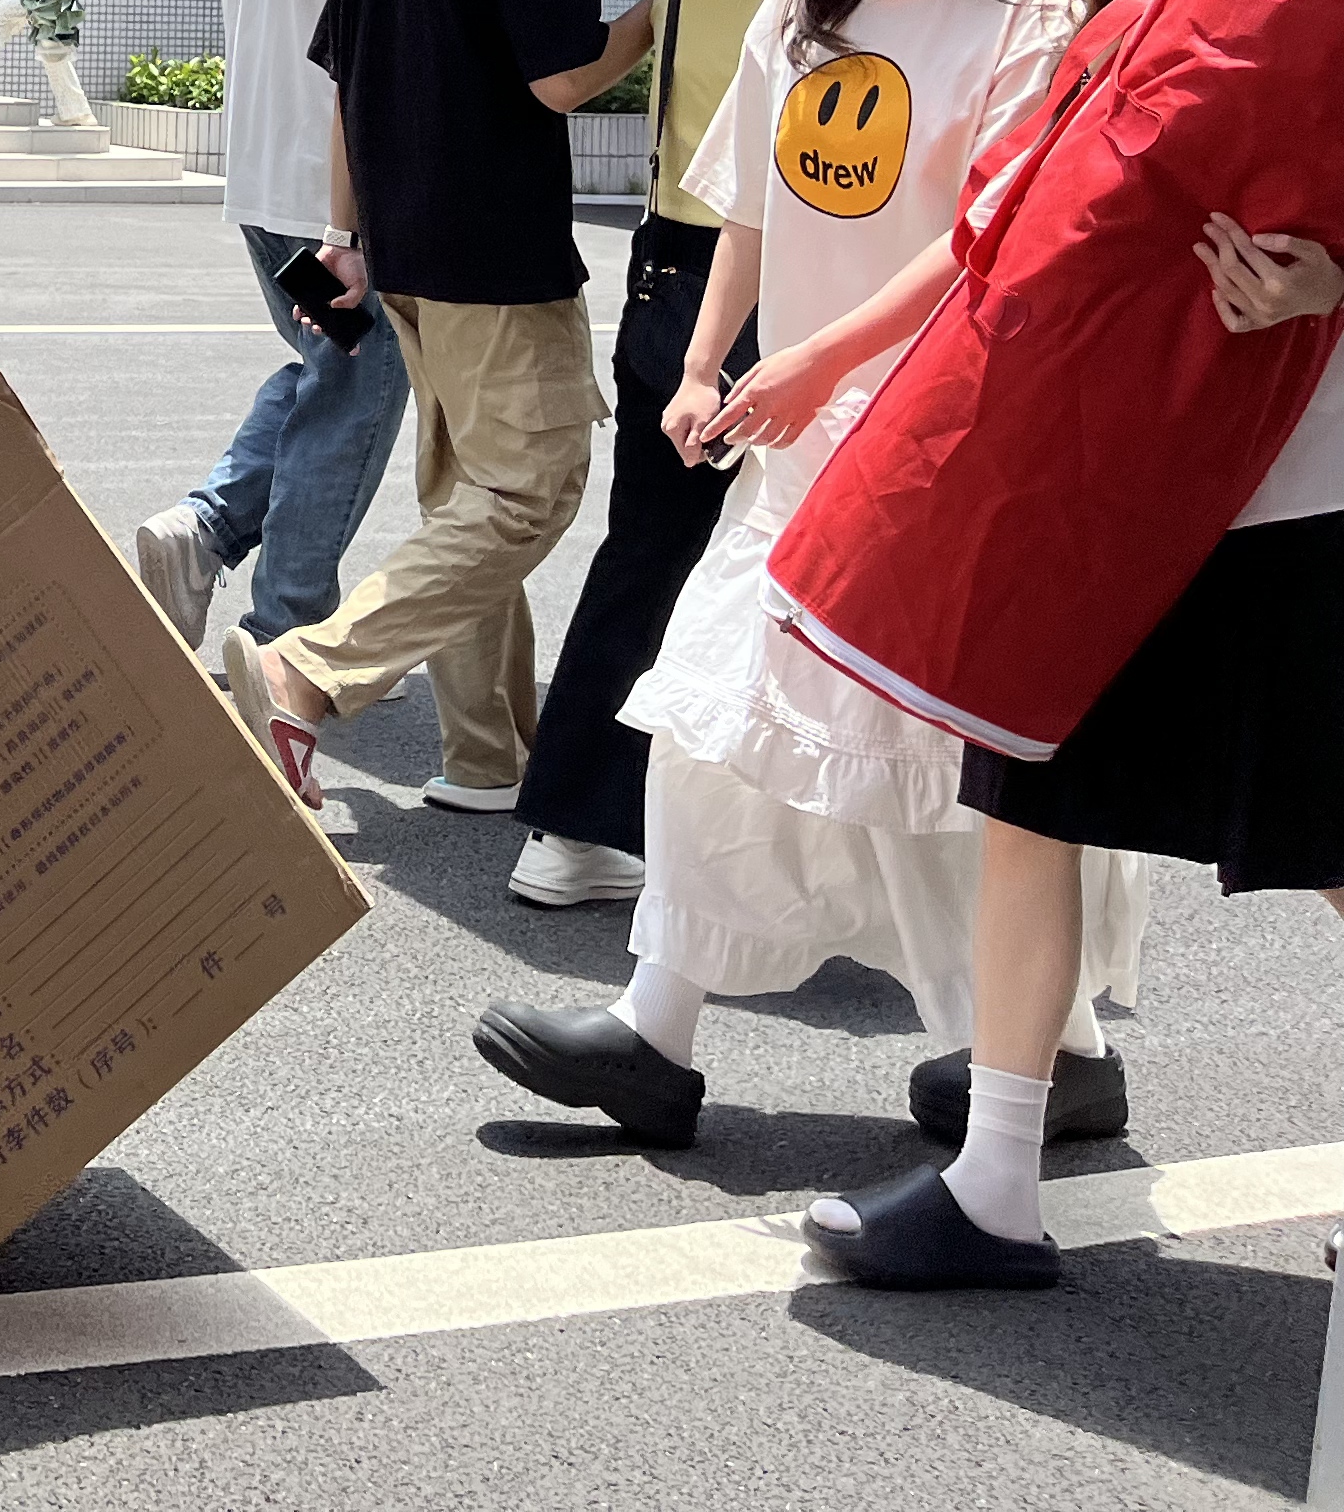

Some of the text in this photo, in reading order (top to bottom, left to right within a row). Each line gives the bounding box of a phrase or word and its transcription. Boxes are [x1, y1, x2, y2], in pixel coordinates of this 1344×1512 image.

[799, 149, 878, 189] drew
[200, 950, 222, 979] 件
[261, 893, 285, 917] 号
